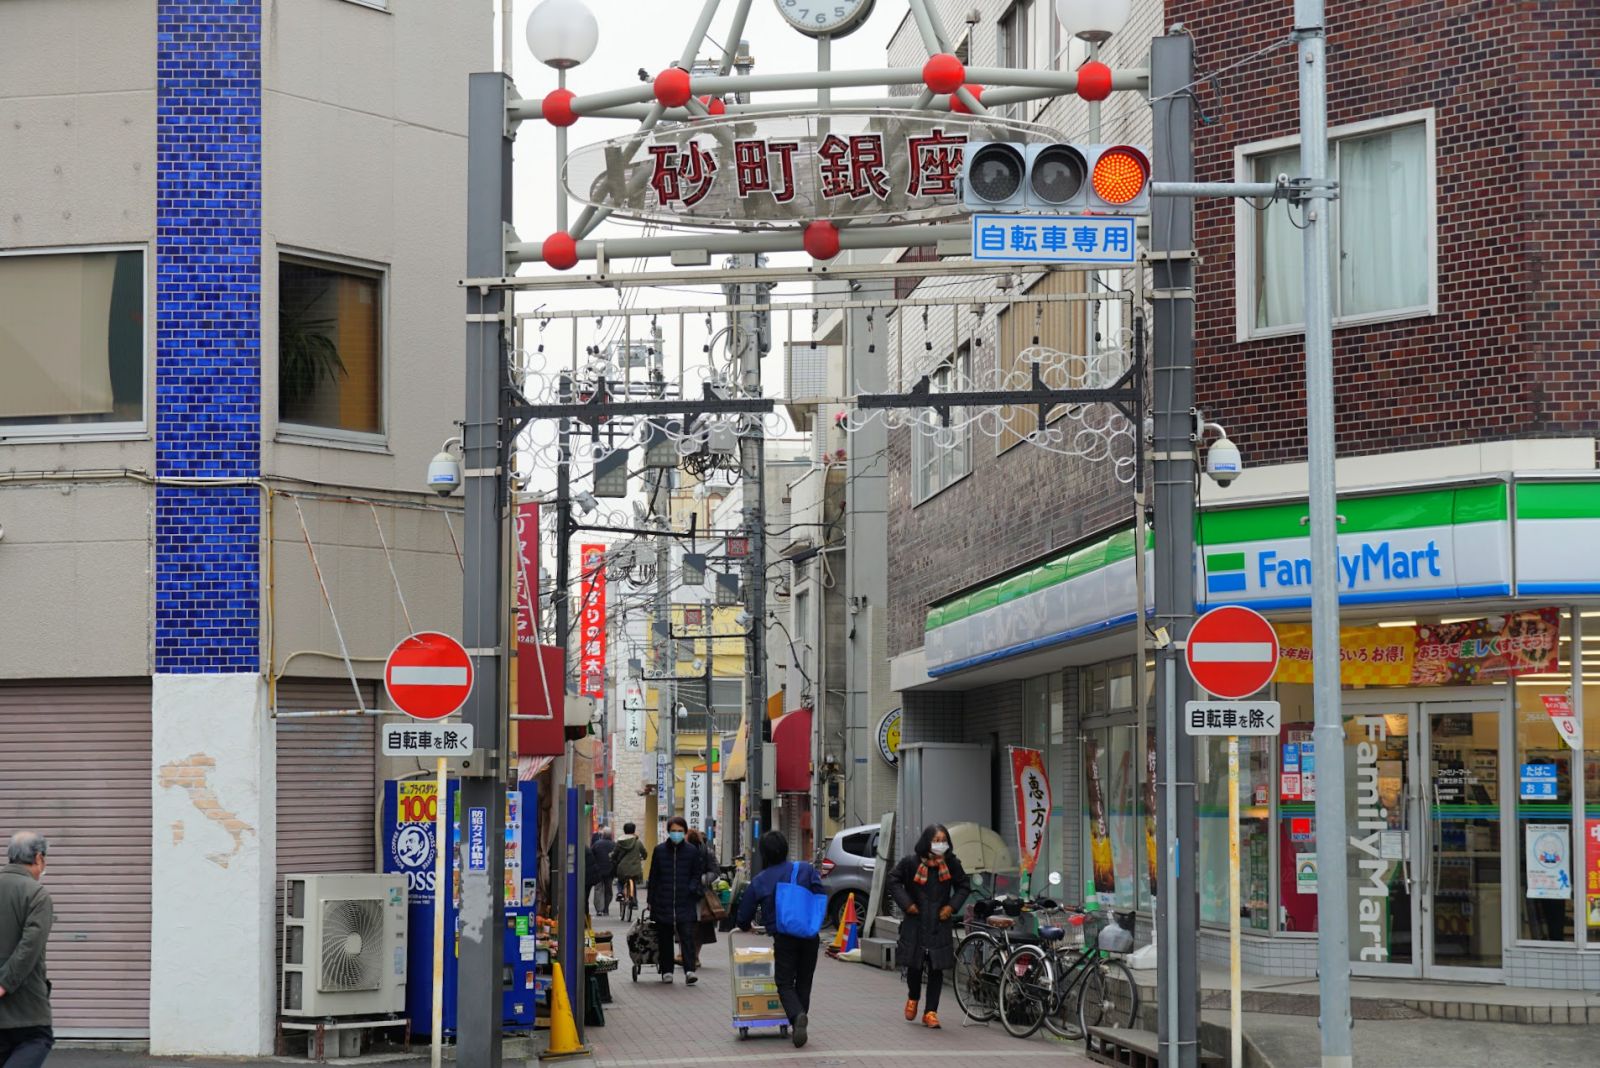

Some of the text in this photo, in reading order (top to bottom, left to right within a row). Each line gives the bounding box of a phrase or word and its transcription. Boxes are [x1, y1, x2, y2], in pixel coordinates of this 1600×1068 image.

[799, 9, 810, 20] 7
[815, 13, 827, 24] 6
[834, 7, 845, 17] 5
[647, 128, 968, 207] 砂町銀座
[979, 225, 1130, 254] 自転車専用
[1258, 540, 1441, 589] FamlyMart
[1191, 709, 1275, 729] 自転車を除く
[388, 731, 468, 750] 自転車を除く
[1526, 765, 1552, 777] たばこ
[471, 810, 484, 869] 防犯カメラ作動中
[1350, 716, 1389, 963] FamilyMart
[391, 871, 436, 891] OSS
